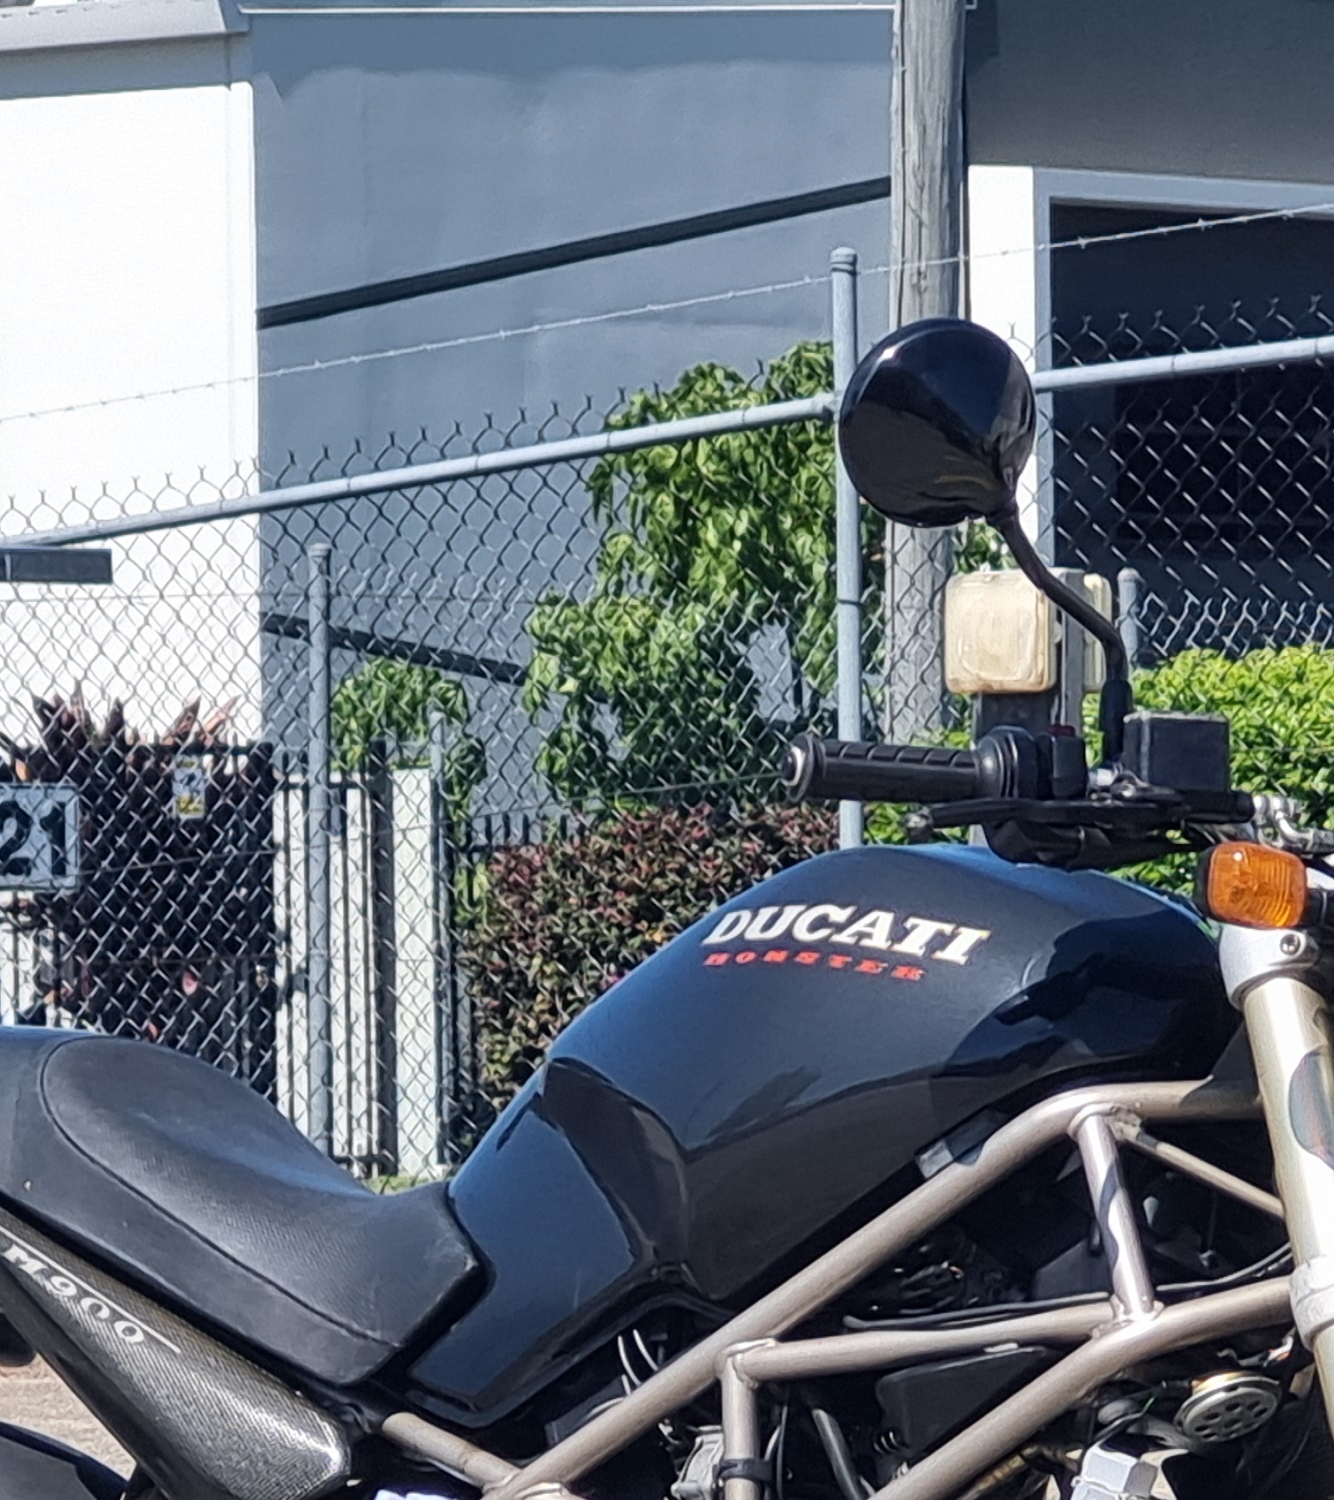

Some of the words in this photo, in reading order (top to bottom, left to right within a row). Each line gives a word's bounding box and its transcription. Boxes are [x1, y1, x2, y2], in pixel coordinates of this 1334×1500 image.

[702, 904, 991, 965] DUCATI
[703, 951, 925, 981] MONSTER
[2, 1244, 145, 1344] M900
